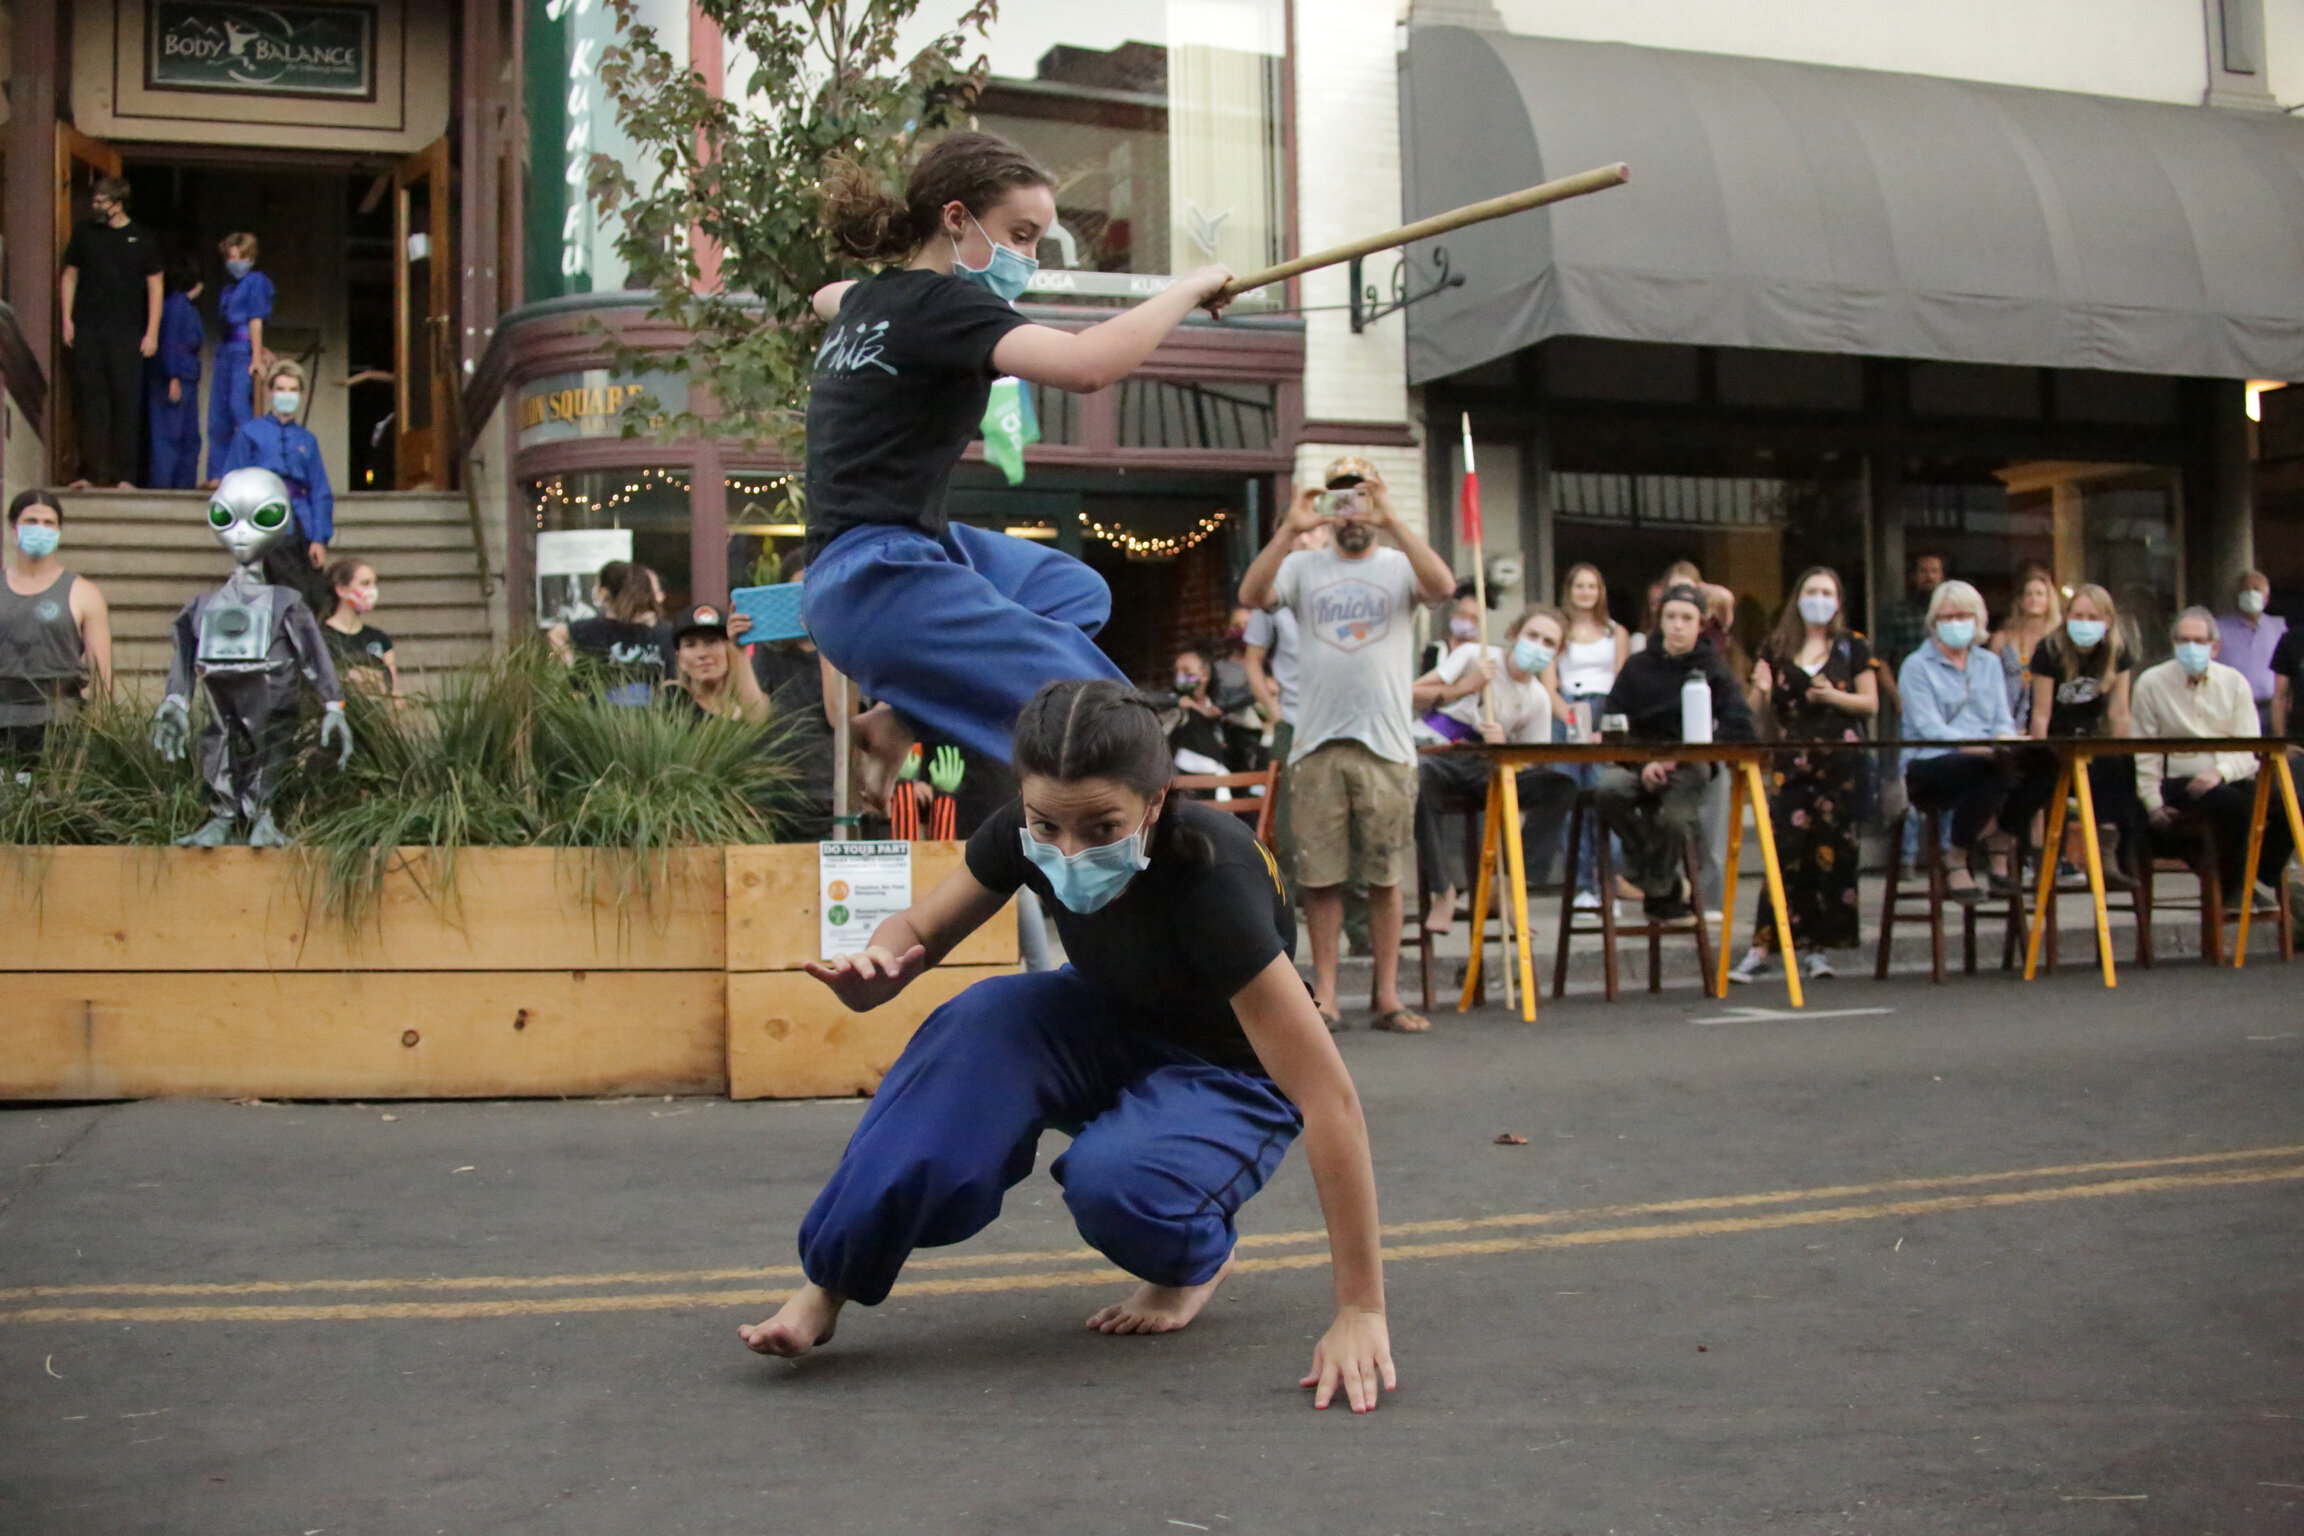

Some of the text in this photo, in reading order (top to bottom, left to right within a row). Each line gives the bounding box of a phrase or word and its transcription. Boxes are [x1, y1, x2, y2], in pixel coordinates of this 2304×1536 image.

[165, 33, 356, 65] BODY BALANCE
[561, 203, 585, 276] FU
[823, 843, 908, 855] DO YOUR PART
